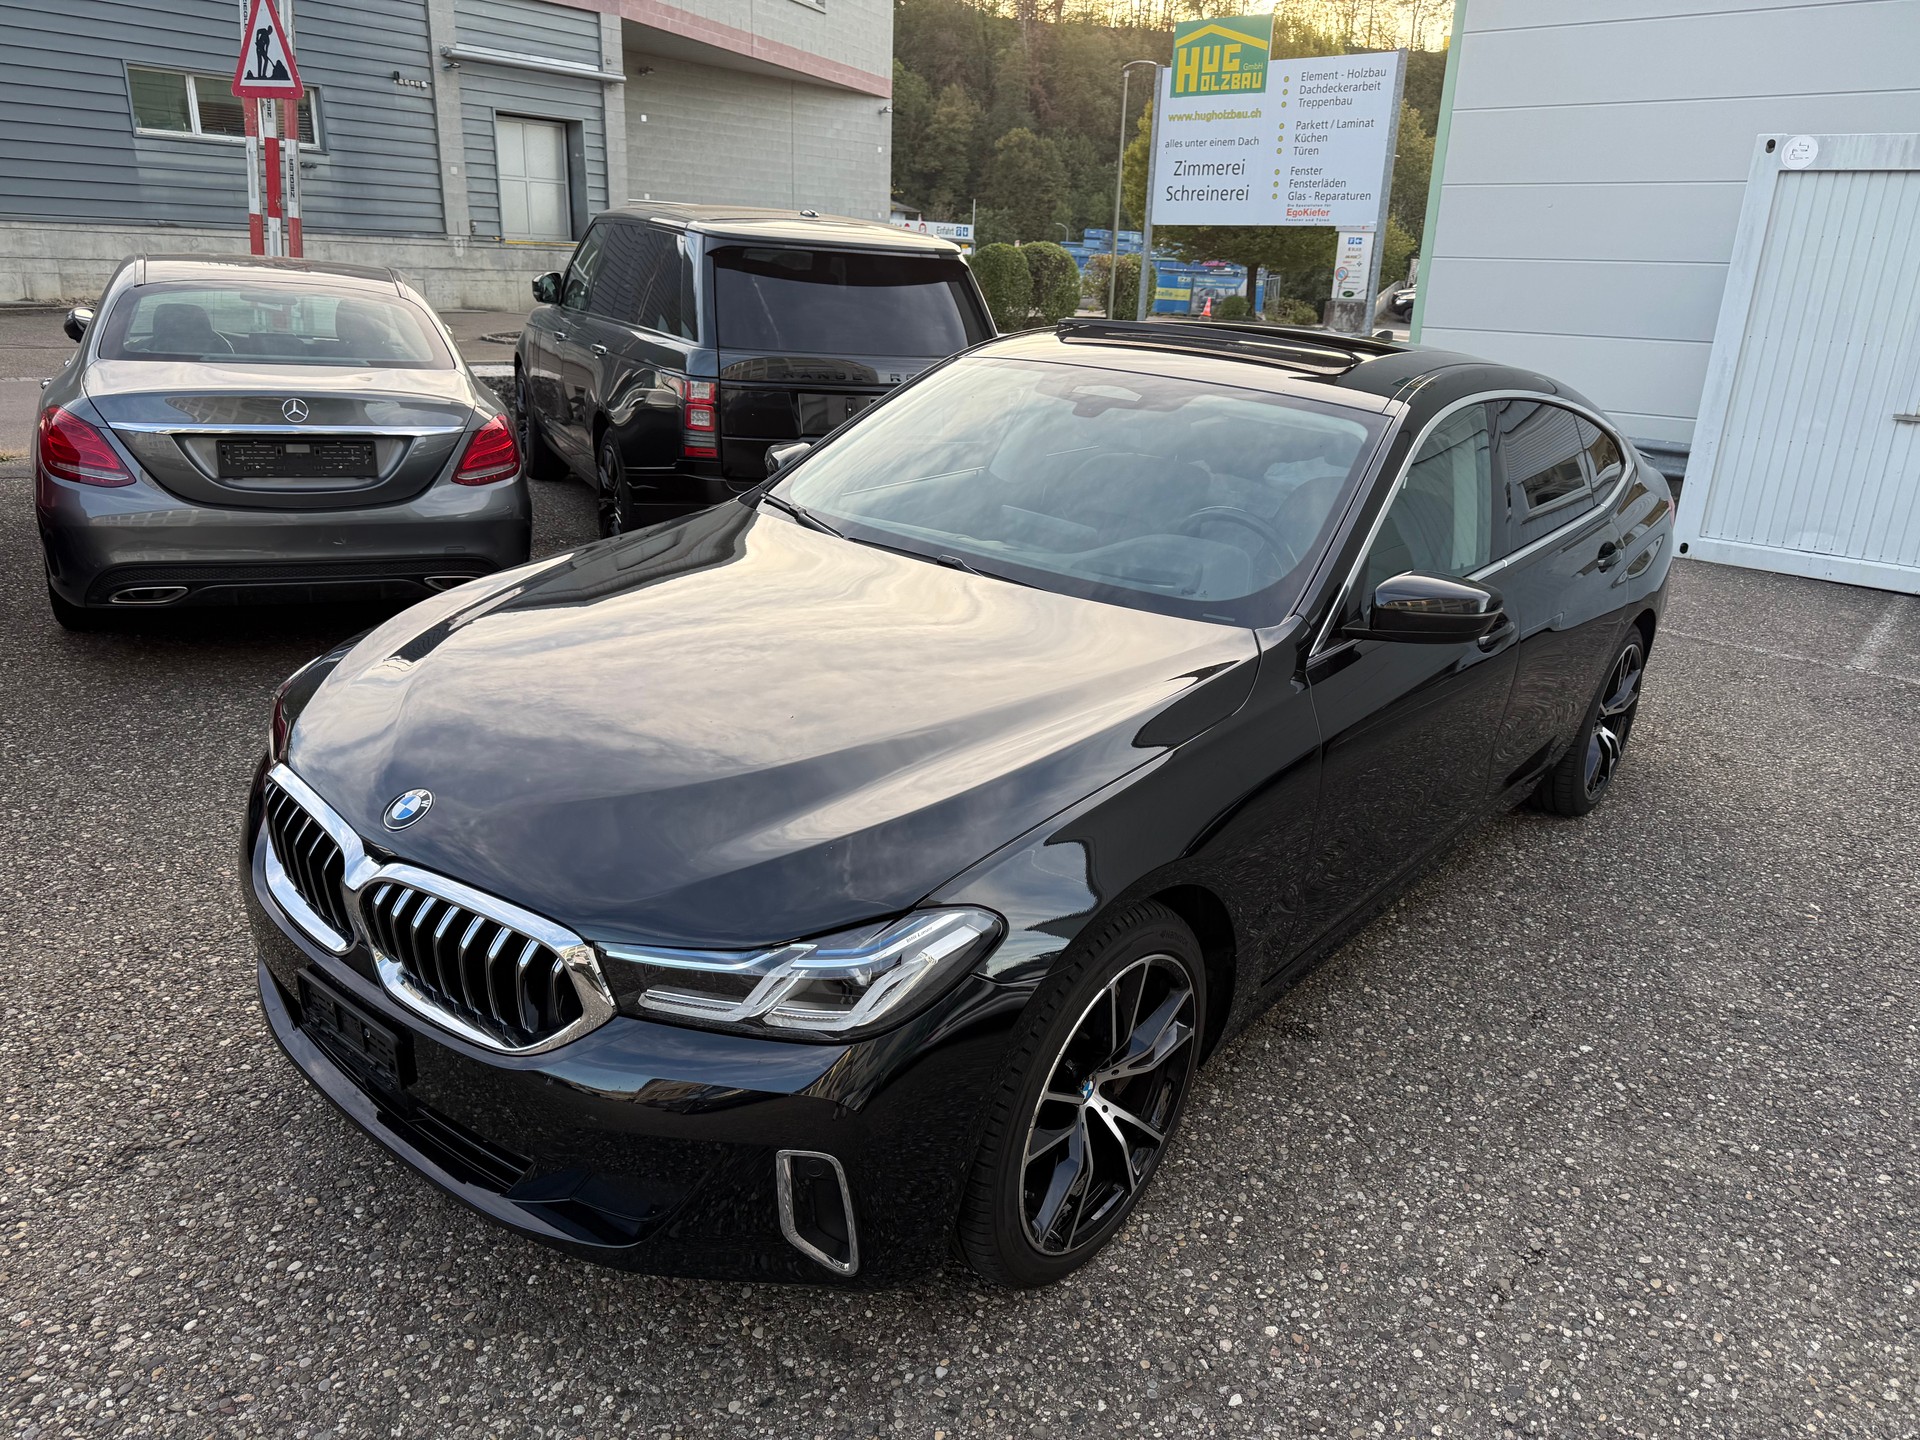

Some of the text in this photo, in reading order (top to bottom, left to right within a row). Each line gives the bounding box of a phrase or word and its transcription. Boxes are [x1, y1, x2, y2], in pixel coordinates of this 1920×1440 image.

[1176, 44, 1241, 92] HUG
[1243, 62, 1263, 71] GmbH
[1301, 71, 1338, 81] Element
[1347, 67, 1386, 79] Holzbau
[1299, 80, 1381, 95] Dachdeckerarbeit
[1298, 96, 1353, 109] Treppenbau
[1168, 107, 1262, 122] www.hugholzbau.ch
[1296, 120, 1329, 130] Parkett
[1336, 118, 1375, 129] Laminat
[1165, 136, 1260, 148] alles unter einem Dach
[1294, 133, 1328, 143] Küchen
[1293, 146, 1319, 156] Türen
[1173, 158, 1246, 176] Zimmerei
[1290, 166, 1323, 176] Fenster
[1289, 178, 1347, 188] Fensterläden
[1165, 184, 1250, 201] Schreinerei
[1288, 191, 1306, 201] Glas
[1314, 191, 1372, 202] Reparaturen
[1286, 208, 1331, 218] EgoKiefer
[783, 371, 863, 381] RANGE
